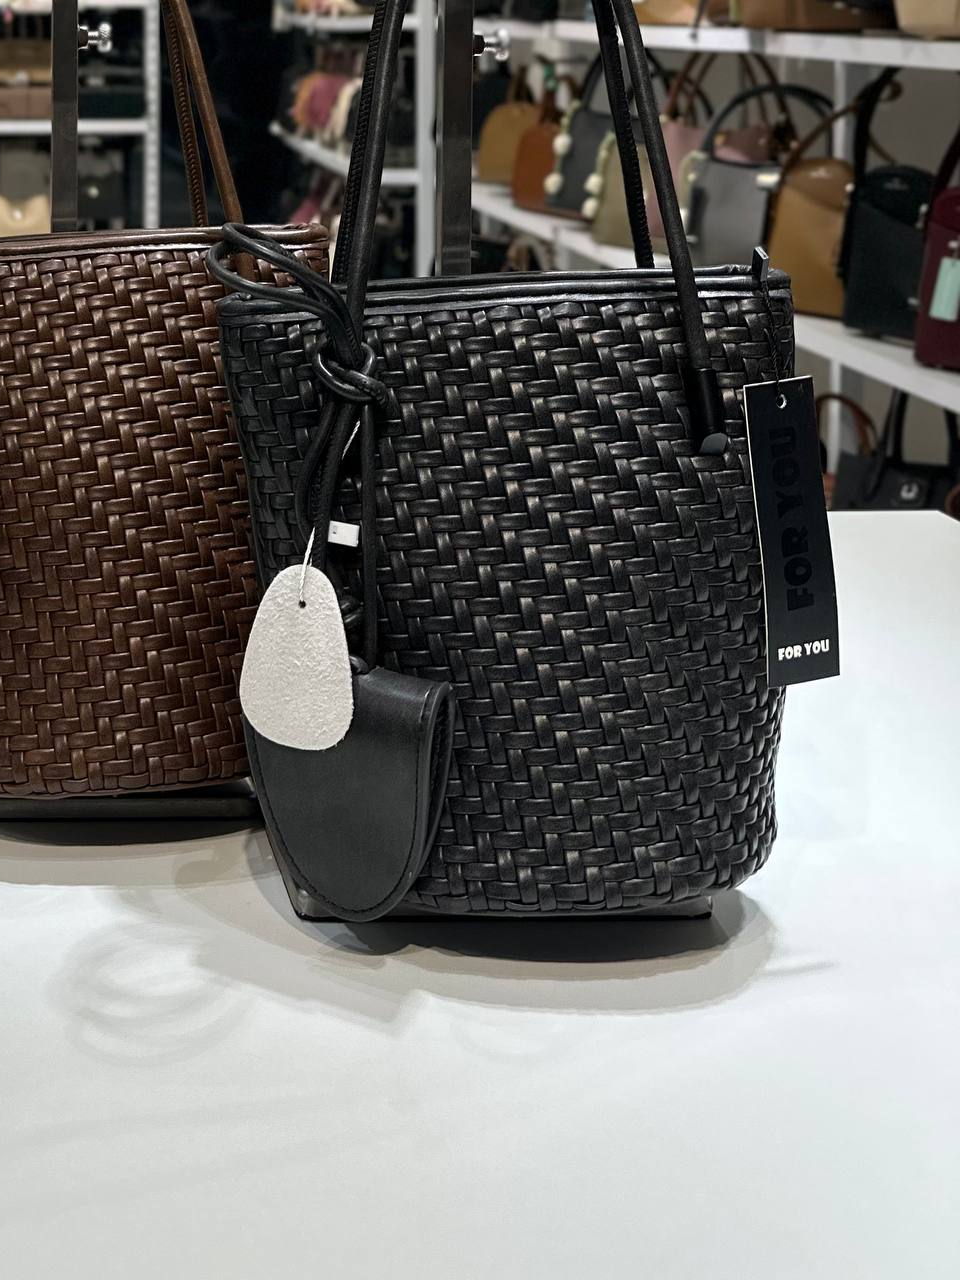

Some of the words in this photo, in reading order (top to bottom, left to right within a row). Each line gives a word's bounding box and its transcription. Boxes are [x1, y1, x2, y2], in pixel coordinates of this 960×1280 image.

[770, 426, 803, 517] YOU
[784, 526, 814, 611] FOR
[778, 644, 802, 661] FOR
[804, 638, 830, 656] YOU
